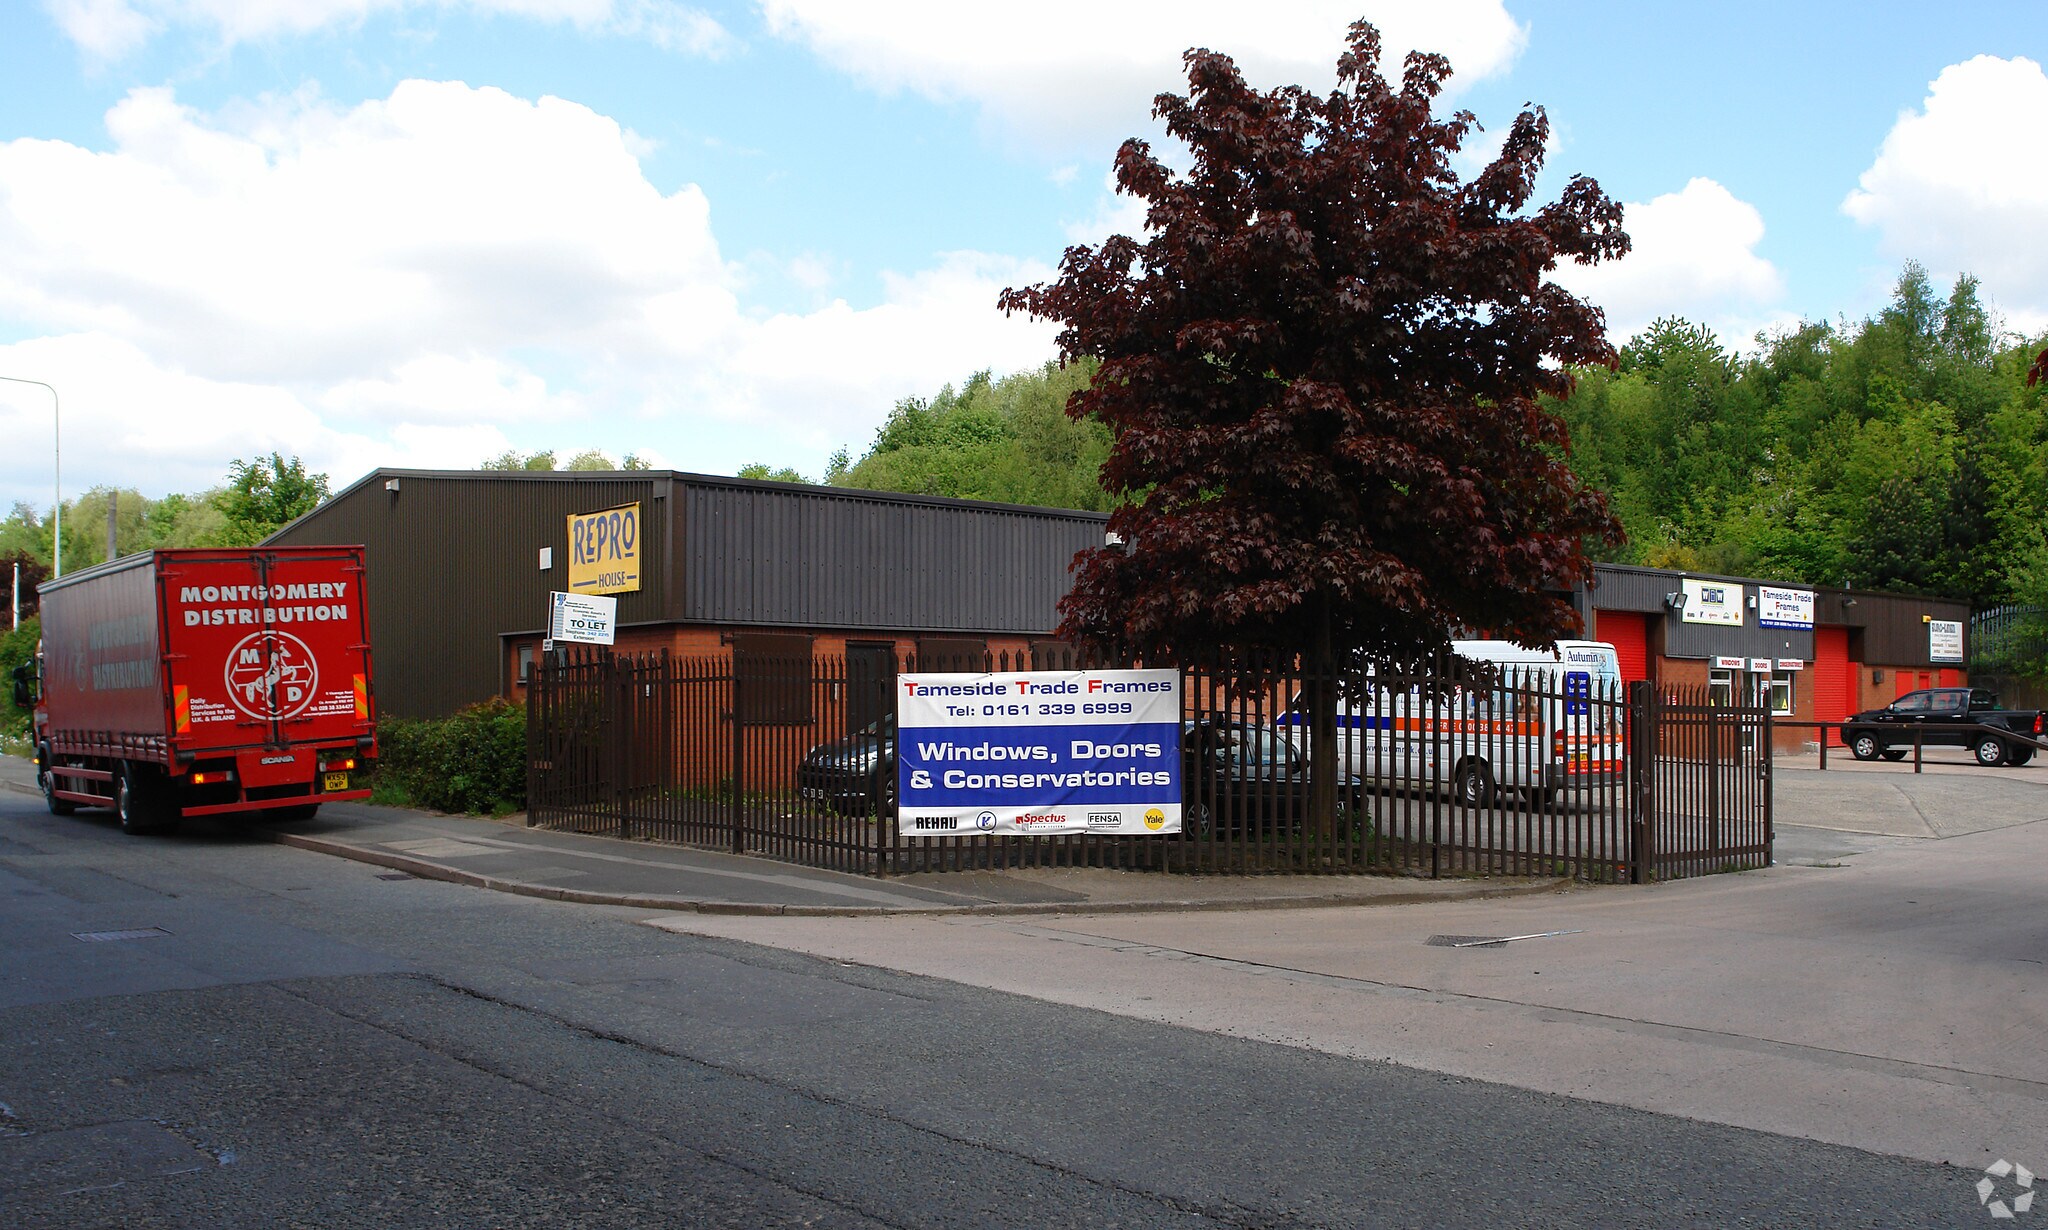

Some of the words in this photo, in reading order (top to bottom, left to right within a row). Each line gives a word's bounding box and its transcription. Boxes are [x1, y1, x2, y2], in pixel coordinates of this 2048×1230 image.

[573, 510, 636, 566] REPRO
[598, 572, 626, 588] HOUSE
[180, 582, 347, 603] MONTGOMERY
[1762, 590, 1792, 600] Tameside
[1794, 593, 1812, 602] Trade
[1776, 602, 1800, 612] Frames
[184, 604, 348, 626] DISTRIBUTION
[570, 619, 585, 628] TO
[588, 621, 607, 630] LET
[240, 649, 260, 664] M
[1568, 651, 1598, 662] Autumn
[92, 658, 153, 691] DISTRIBUTION
[287, 686, 302, 702] D
[904, 682, 1006, 696] Tameside
[1016, 681, 1078, 694] Trade
[1088, 680, 1172, 693] Frames
[946, 706, 975, 716] Tel:
[983, 704, 1029, 716] 0161
[1039, 704, 1075, 715] 339
[1083, 703, 1132, 714] 6999
[918, 741, 1058, 764] Windows,
[1071, 740, 1162, 759] Doors
[261, 756, 294, 764] SCANIA
[910, 770, 933, 788] &
[944, 767, 1170, 788] Conservatories
[916, 817, 957, 829] REHAU
[1024, 813, 1066, 823] Spectus
[1146, 815, 1163, 824] Yale
